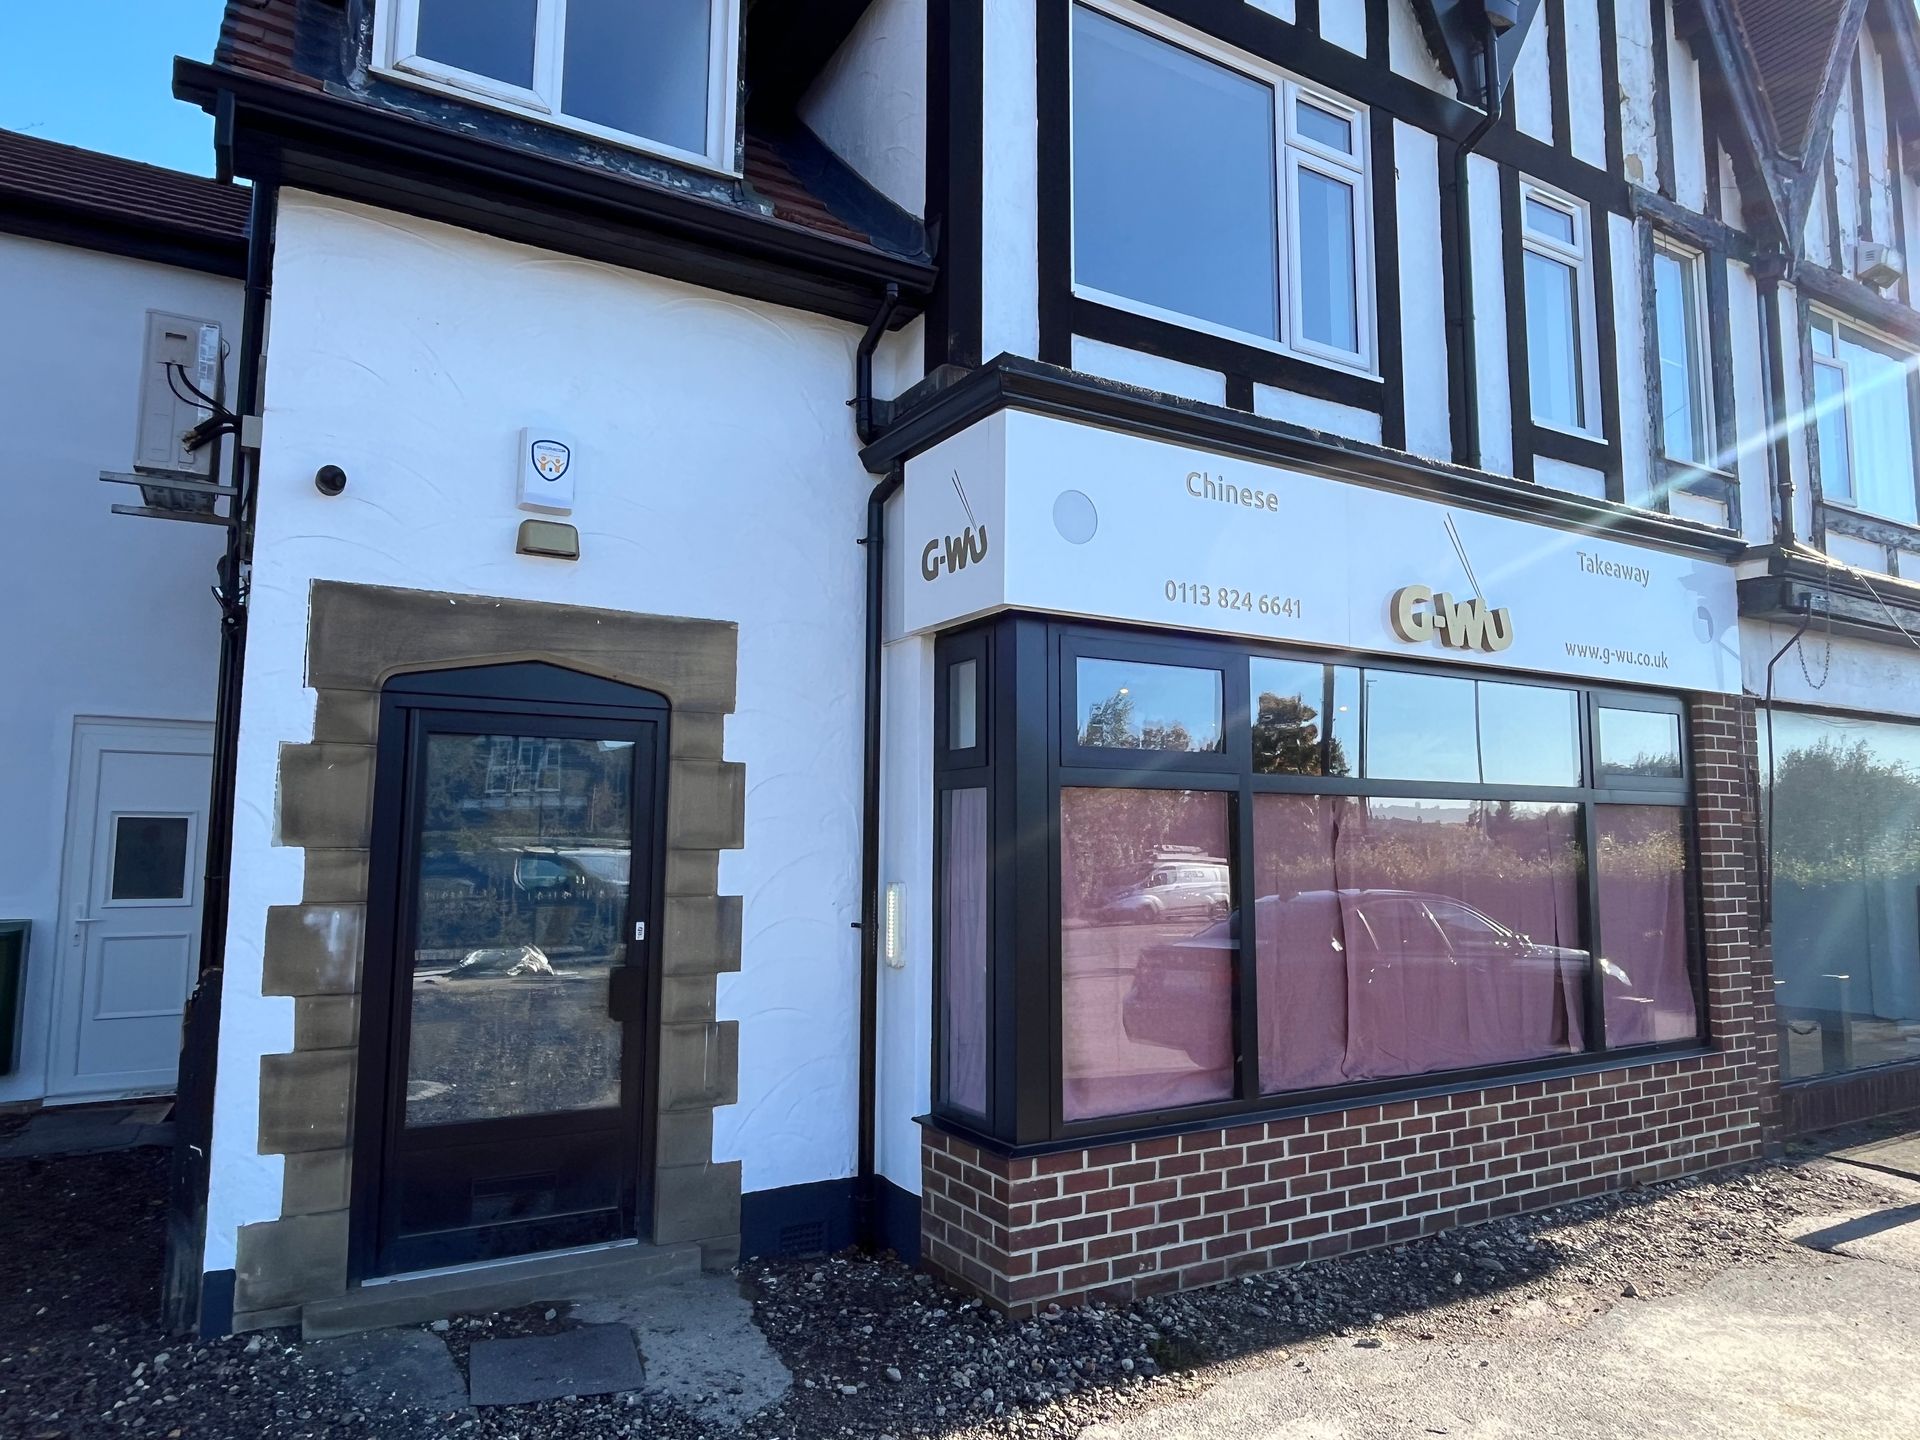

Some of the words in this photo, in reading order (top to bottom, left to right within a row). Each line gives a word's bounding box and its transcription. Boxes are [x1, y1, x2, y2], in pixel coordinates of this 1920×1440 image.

[1186, 471, 1279, 511] Chinese
[1576, 551, 1650, 588] Takeaway
[1164, 579, 1211, 606] 0113
[1217, 587, 1253, 612] 824
[1258, 594, 1301, 619] 6641
[1565, 642, 1669, 669] www.g-wu.co.uk
